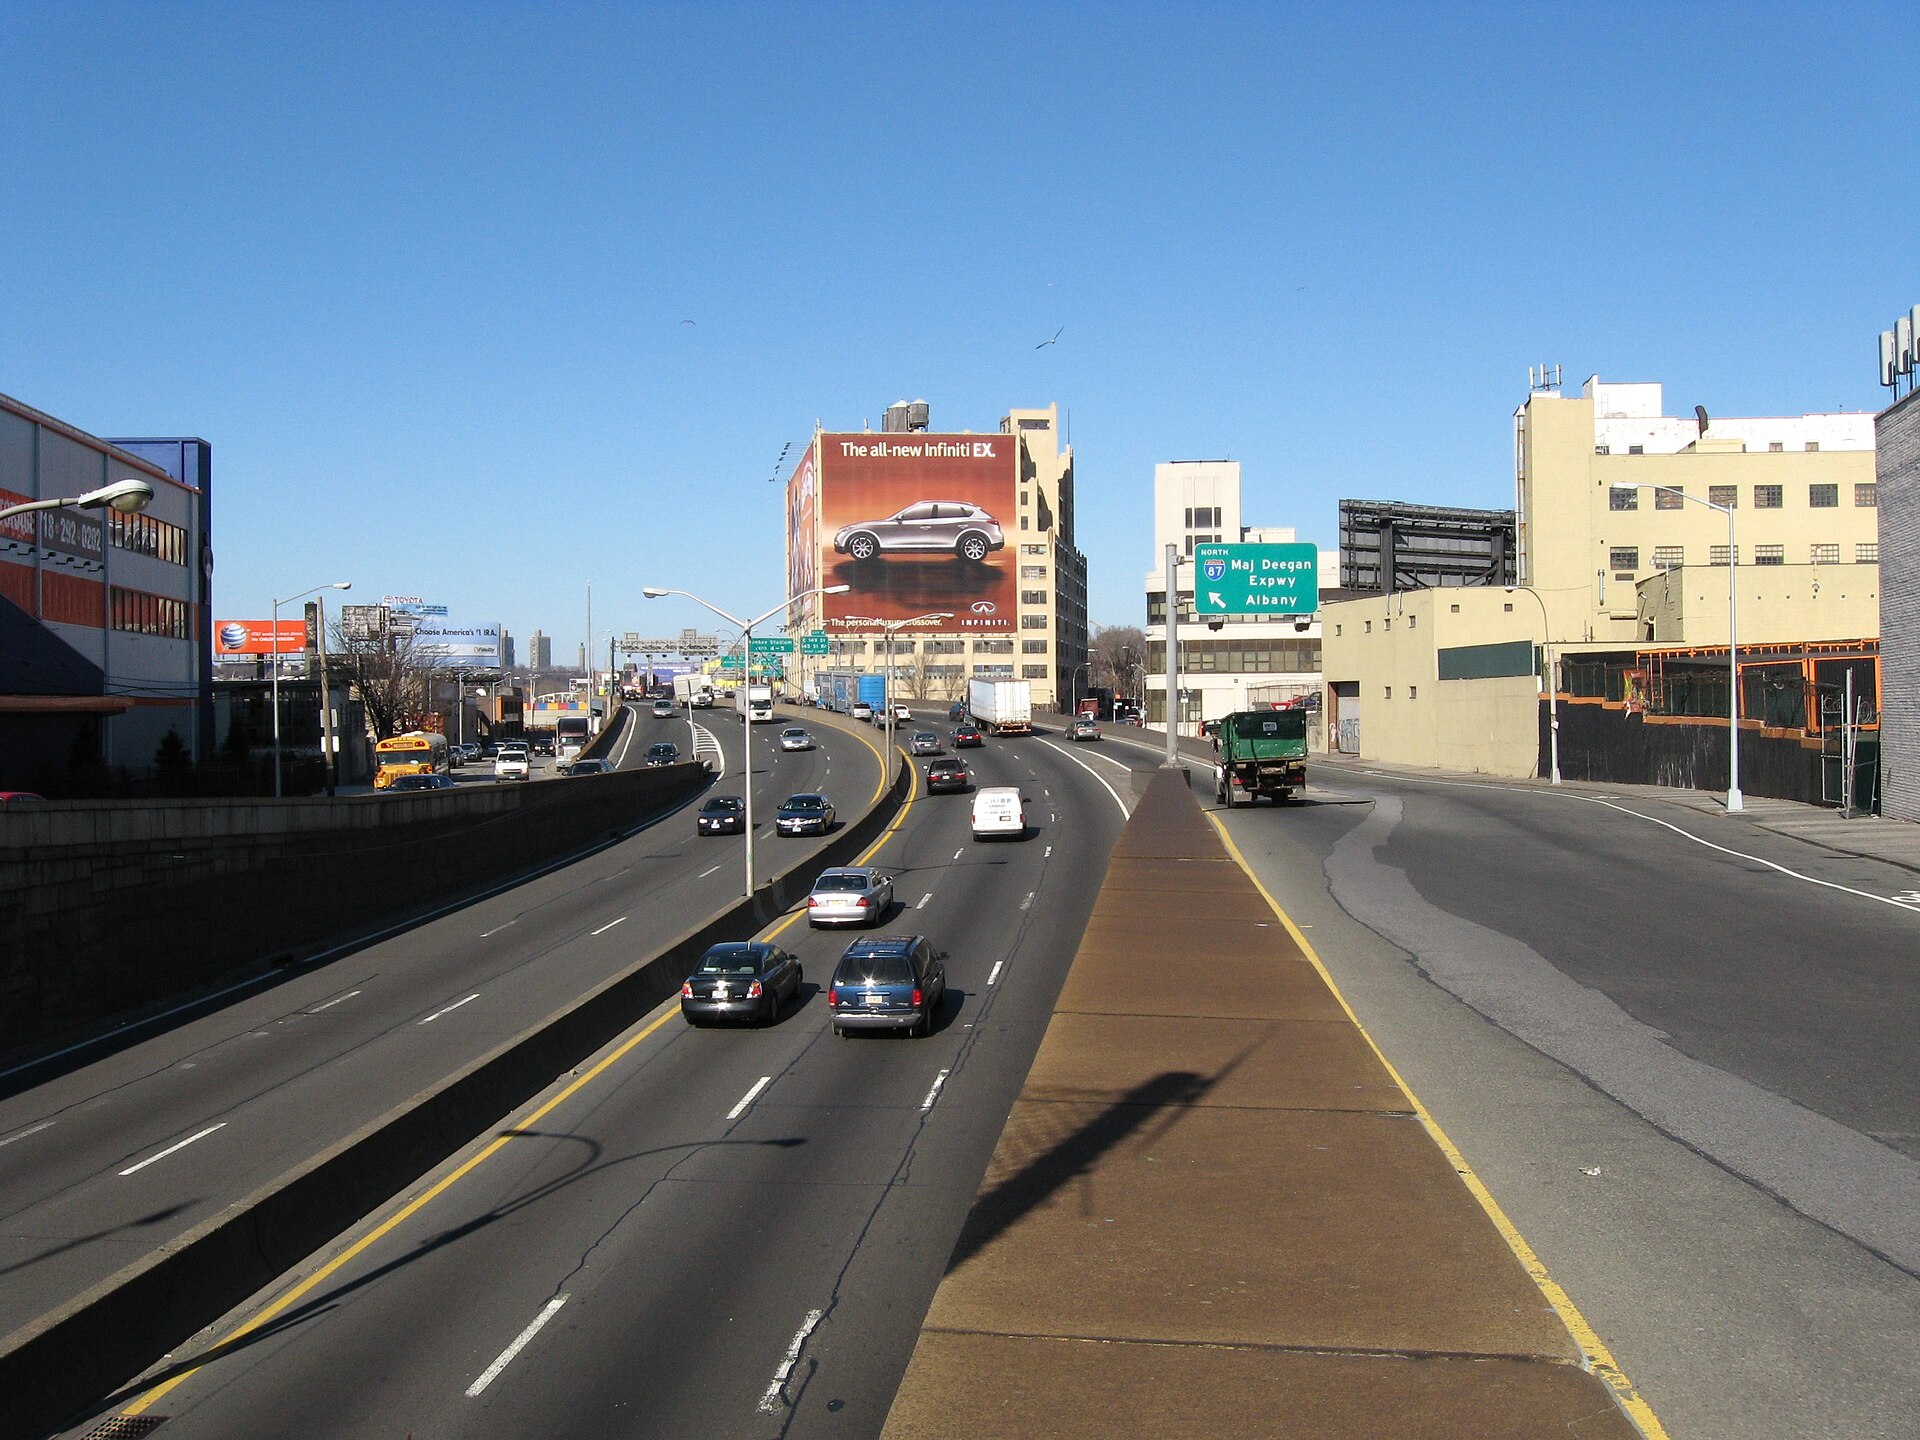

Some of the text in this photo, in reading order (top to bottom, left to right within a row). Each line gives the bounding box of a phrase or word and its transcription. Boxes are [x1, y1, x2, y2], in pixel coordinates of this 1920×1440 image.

[840, 442, 996, 457] The all-new Infiniti EX.
[1208, 566, 1223, 576] 87
[1232, 560, 1312, 572] Maj Deegan
[1249, 575, 1296, 588] Expwy
[1246, 595, 1297, 607] Albany
[831, 618, 845, 626] The
